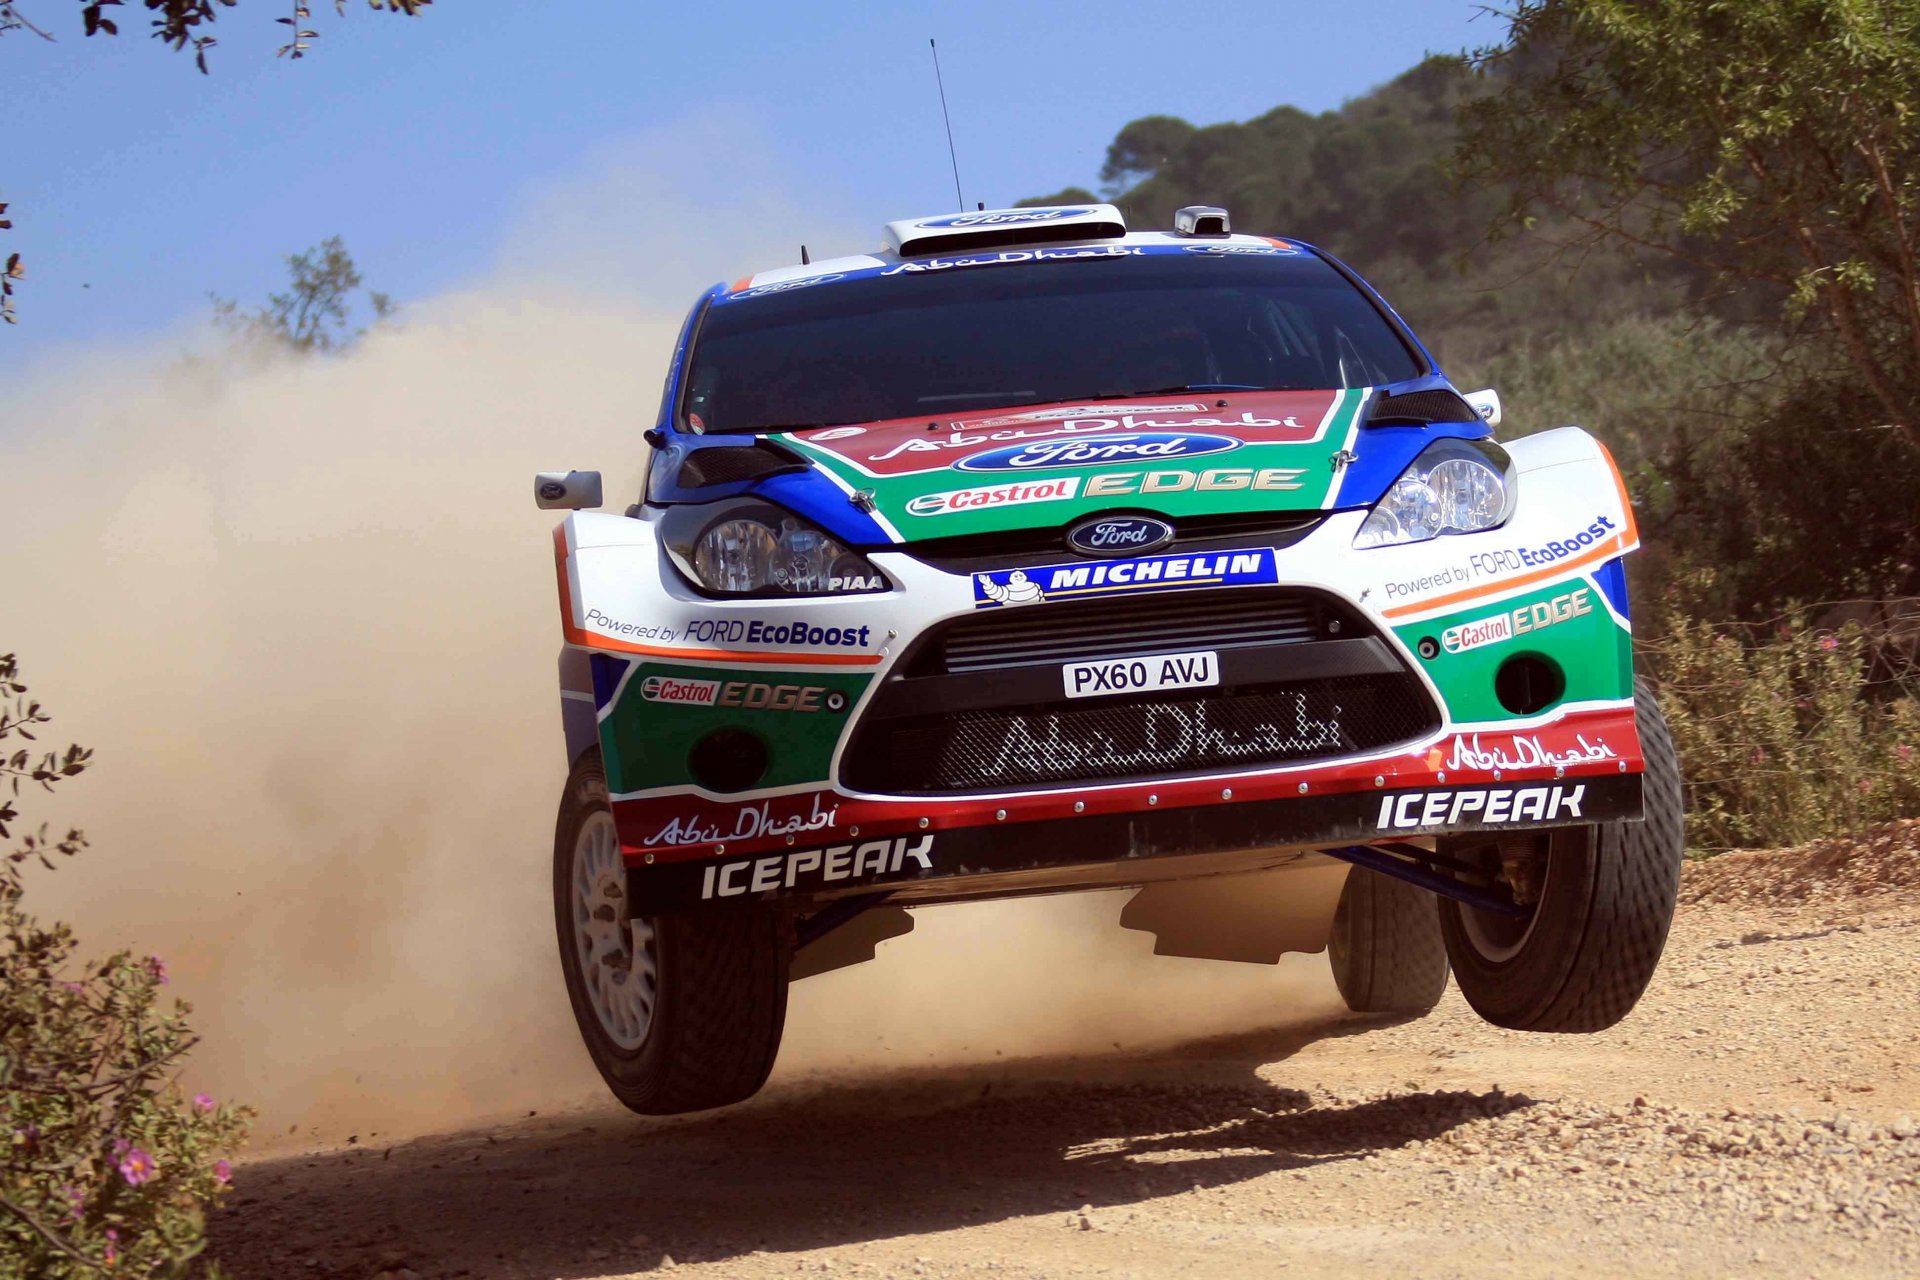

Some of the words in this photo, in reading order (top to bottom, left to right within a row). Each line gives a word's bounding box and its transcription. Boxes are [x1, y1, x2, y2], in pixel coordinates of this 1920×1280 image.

[951, 210, 1063, 226] Ford
[881, 259, 998, 275] Abu
[998, 246, 1146, 263] Dhabi
[868, 430, 1056, 461] Abu
[1058, 412, 1304, 434] Dhabi
[1008, 435, 1187, 467] Ford
[949, 480, 1067, 509] Castrol
[1082, 468, 1307, 498] EDGE
[1091, 521, 1147, 546] Ford
[1050, 553, 1262, 589] MICHELIN
[1385, 568, 1451, 599] Powered
[1453, 566, 1471, 582] by
[1469, 549, 1521, 577] FORD
[1517, 515, 1616, 567] EcoBoost
[828, 575, 884, 591] PIAA
[585, 608, 657, 640] Powered
[659, 627, 680, 643] by
[683, 620, 744, 643] FORD
[746, 620, 870, 647] EcoBoost
[1461, 617, 1509, 647] Castrol
[1511, 587, 1593, 637] EDGE
[1074, 661, 1147, 693] PX60
[1158, 656, 1209, 685] AVJ
[657, 680, 715, 702] Castrol
[716, 681, 827, 712] EDGE
[979, 715, 1125, 776] Abu
[1138, 693, 1342, 766] Dhabi
[1446, 733, 1512, 770] Abu
[1511, 733, 1617, 768] Dhabi
[644, 814, 732, 845] Abu
[732, 793, 840, 840] Dhabi
[1376, 784, 1586, 829] ICEPEAK
[701, 834, 935, 899] ICEPEAK
